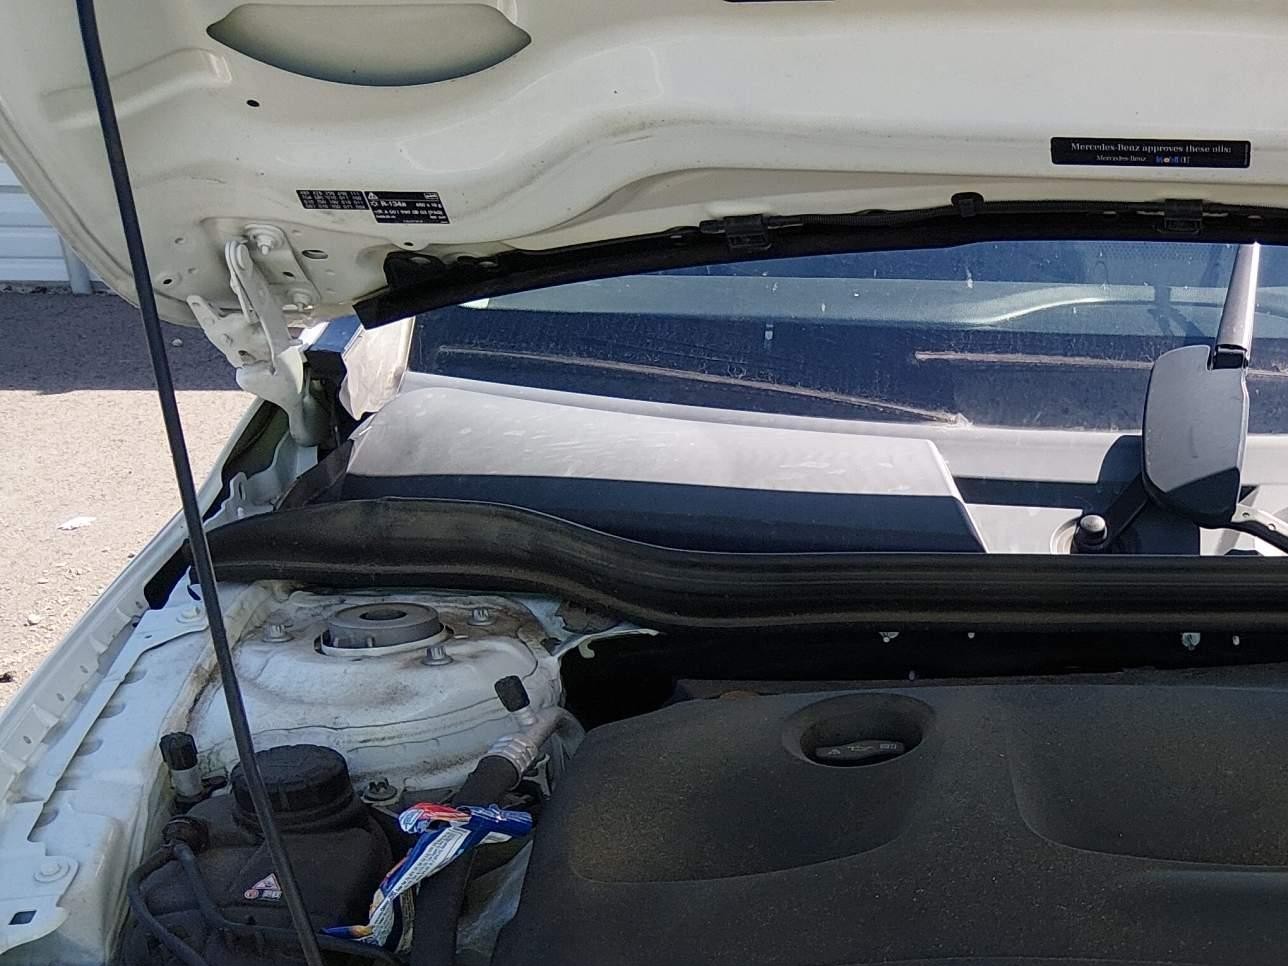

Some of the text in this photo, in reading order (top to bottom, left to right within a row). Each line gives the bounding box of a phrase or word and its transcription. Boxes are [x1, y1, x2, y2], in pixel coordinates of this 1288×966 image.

[1071, 142, 1140, 151] Mercedes-Benz
[1142, 144, 1186, 153] approves
[1186, 144, 1210, 153] these
